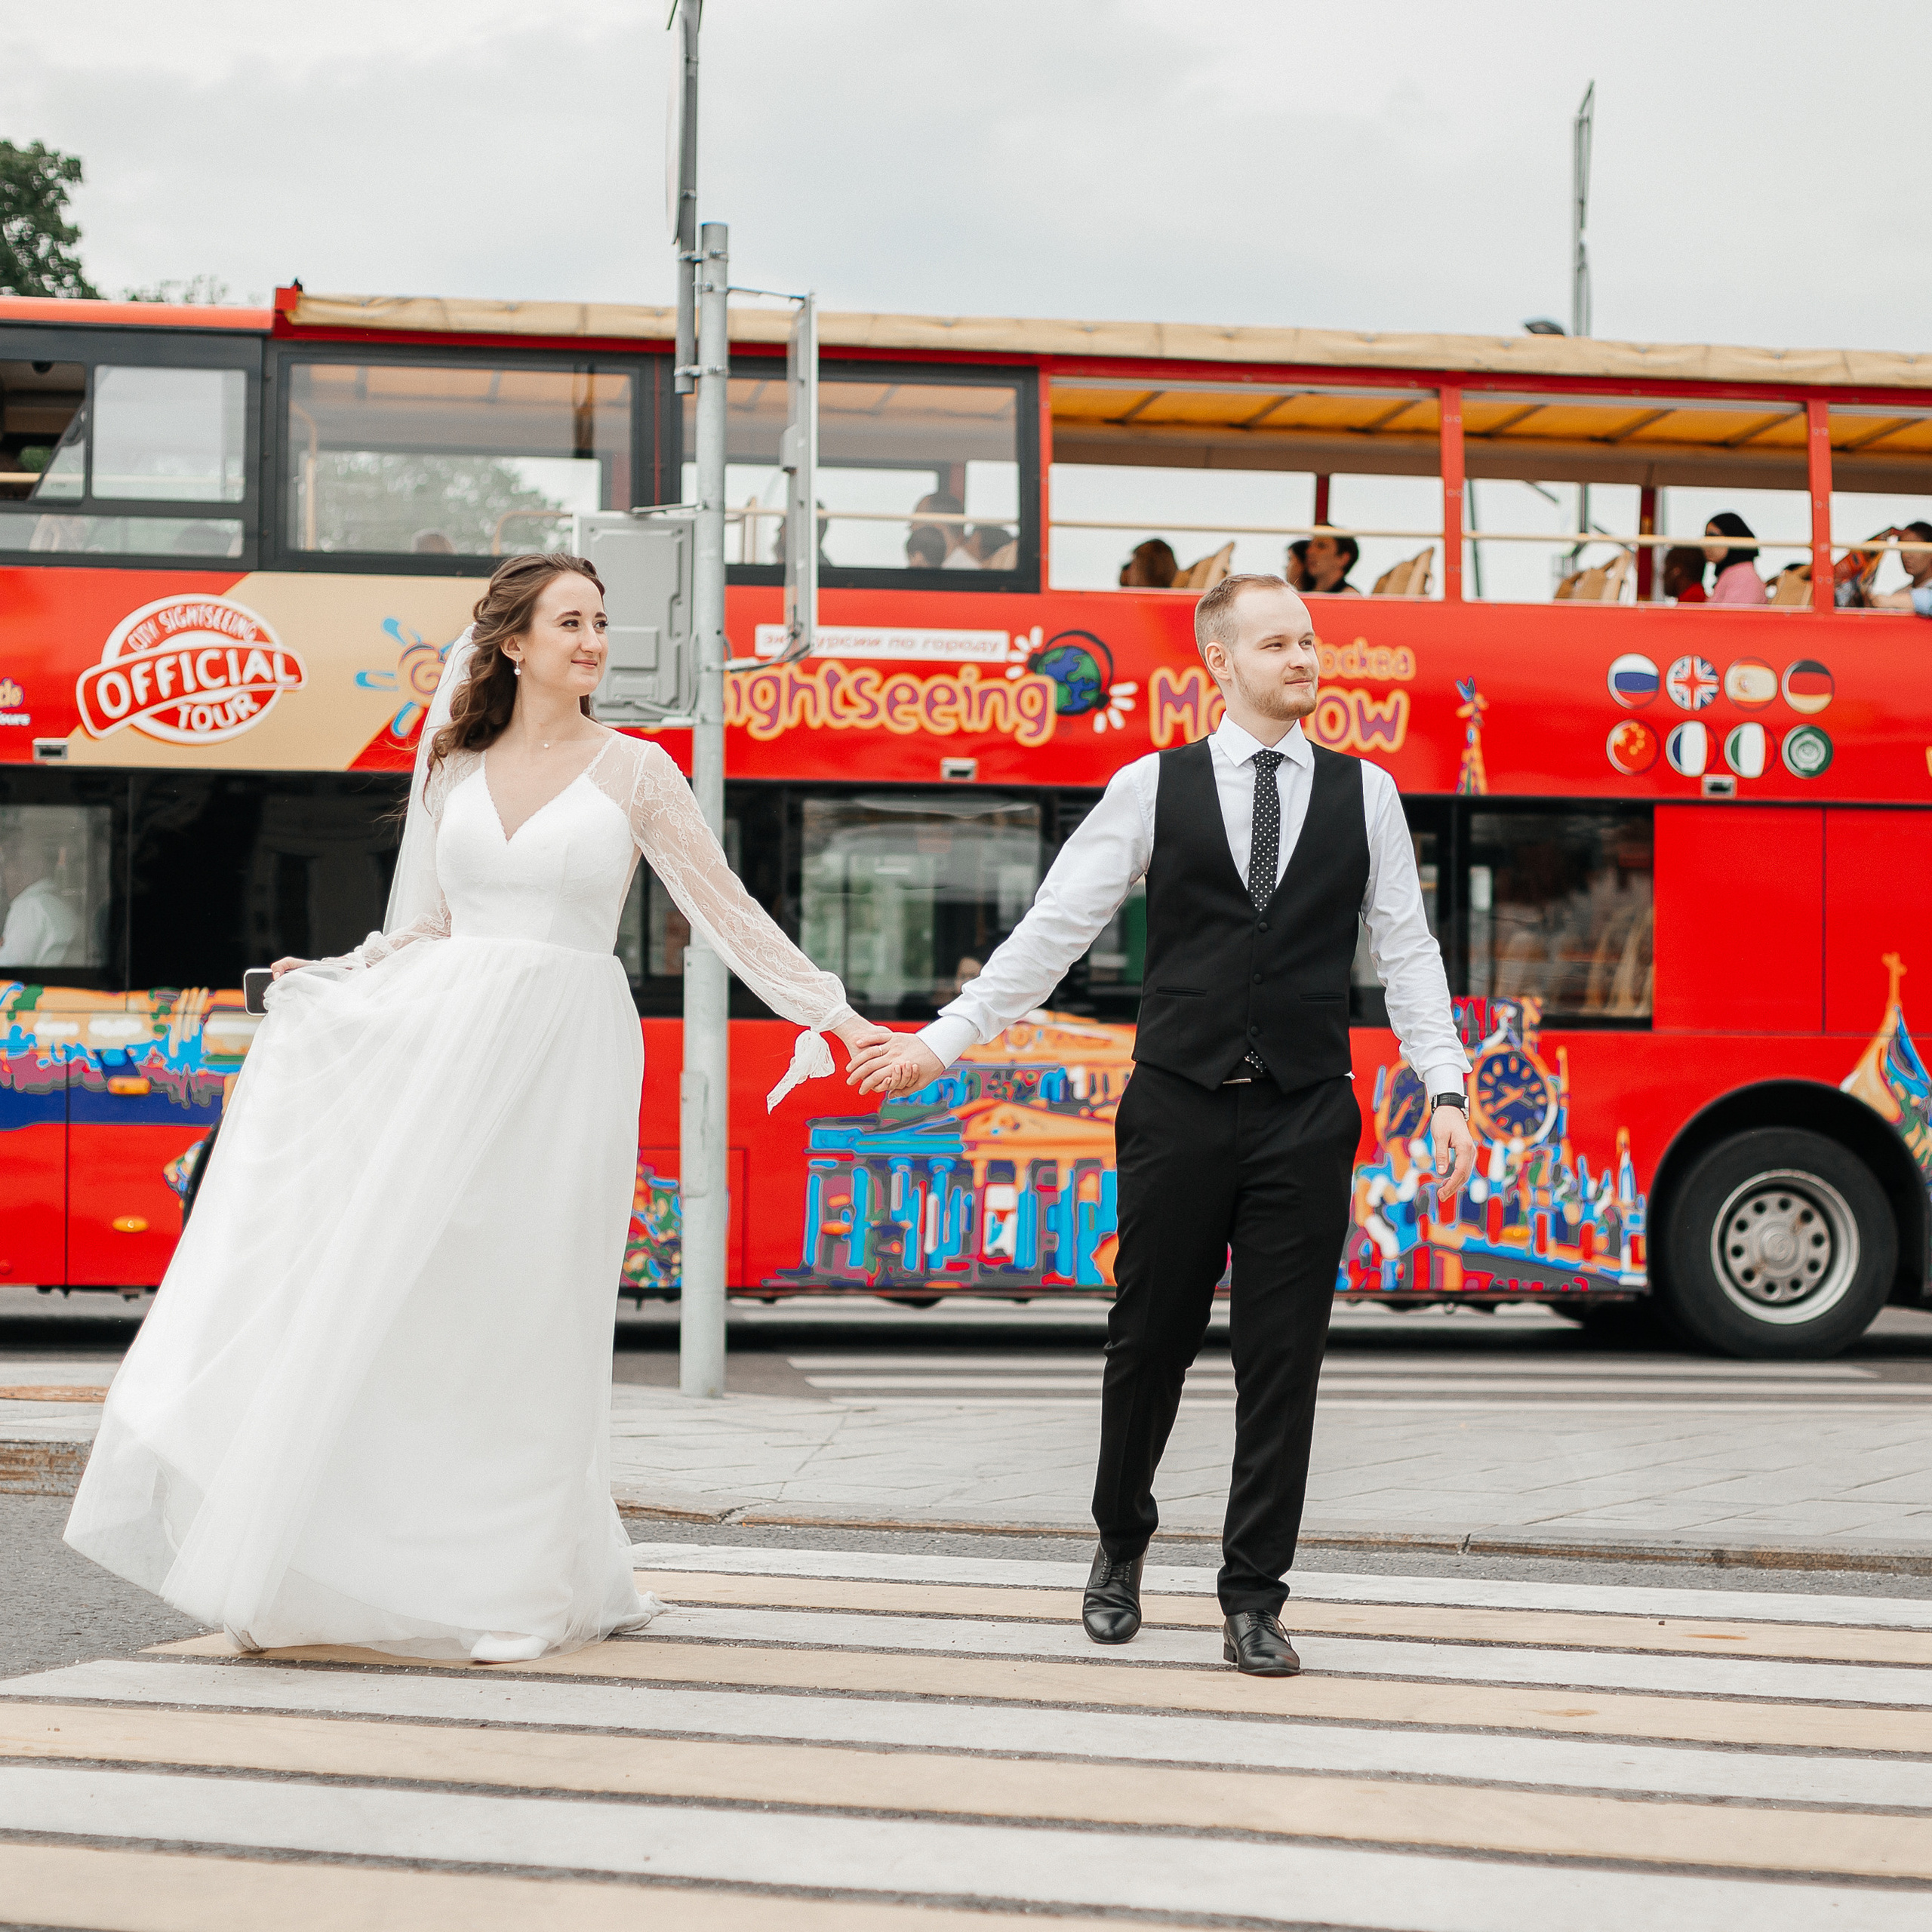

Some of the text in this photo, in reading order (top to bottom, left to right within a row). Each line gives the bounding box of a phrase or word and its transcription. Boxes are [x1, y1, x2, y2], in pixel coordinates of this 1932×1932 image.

[127, 605, 259, 652] CITY SIGHTSEEING
[764, 635, 882, 650] экурсии
[96, 648, 300, 719] OFFICIAL
[722, 660, 1056, 748] ightseeing
[176, 692, 261, 731] TOUR
